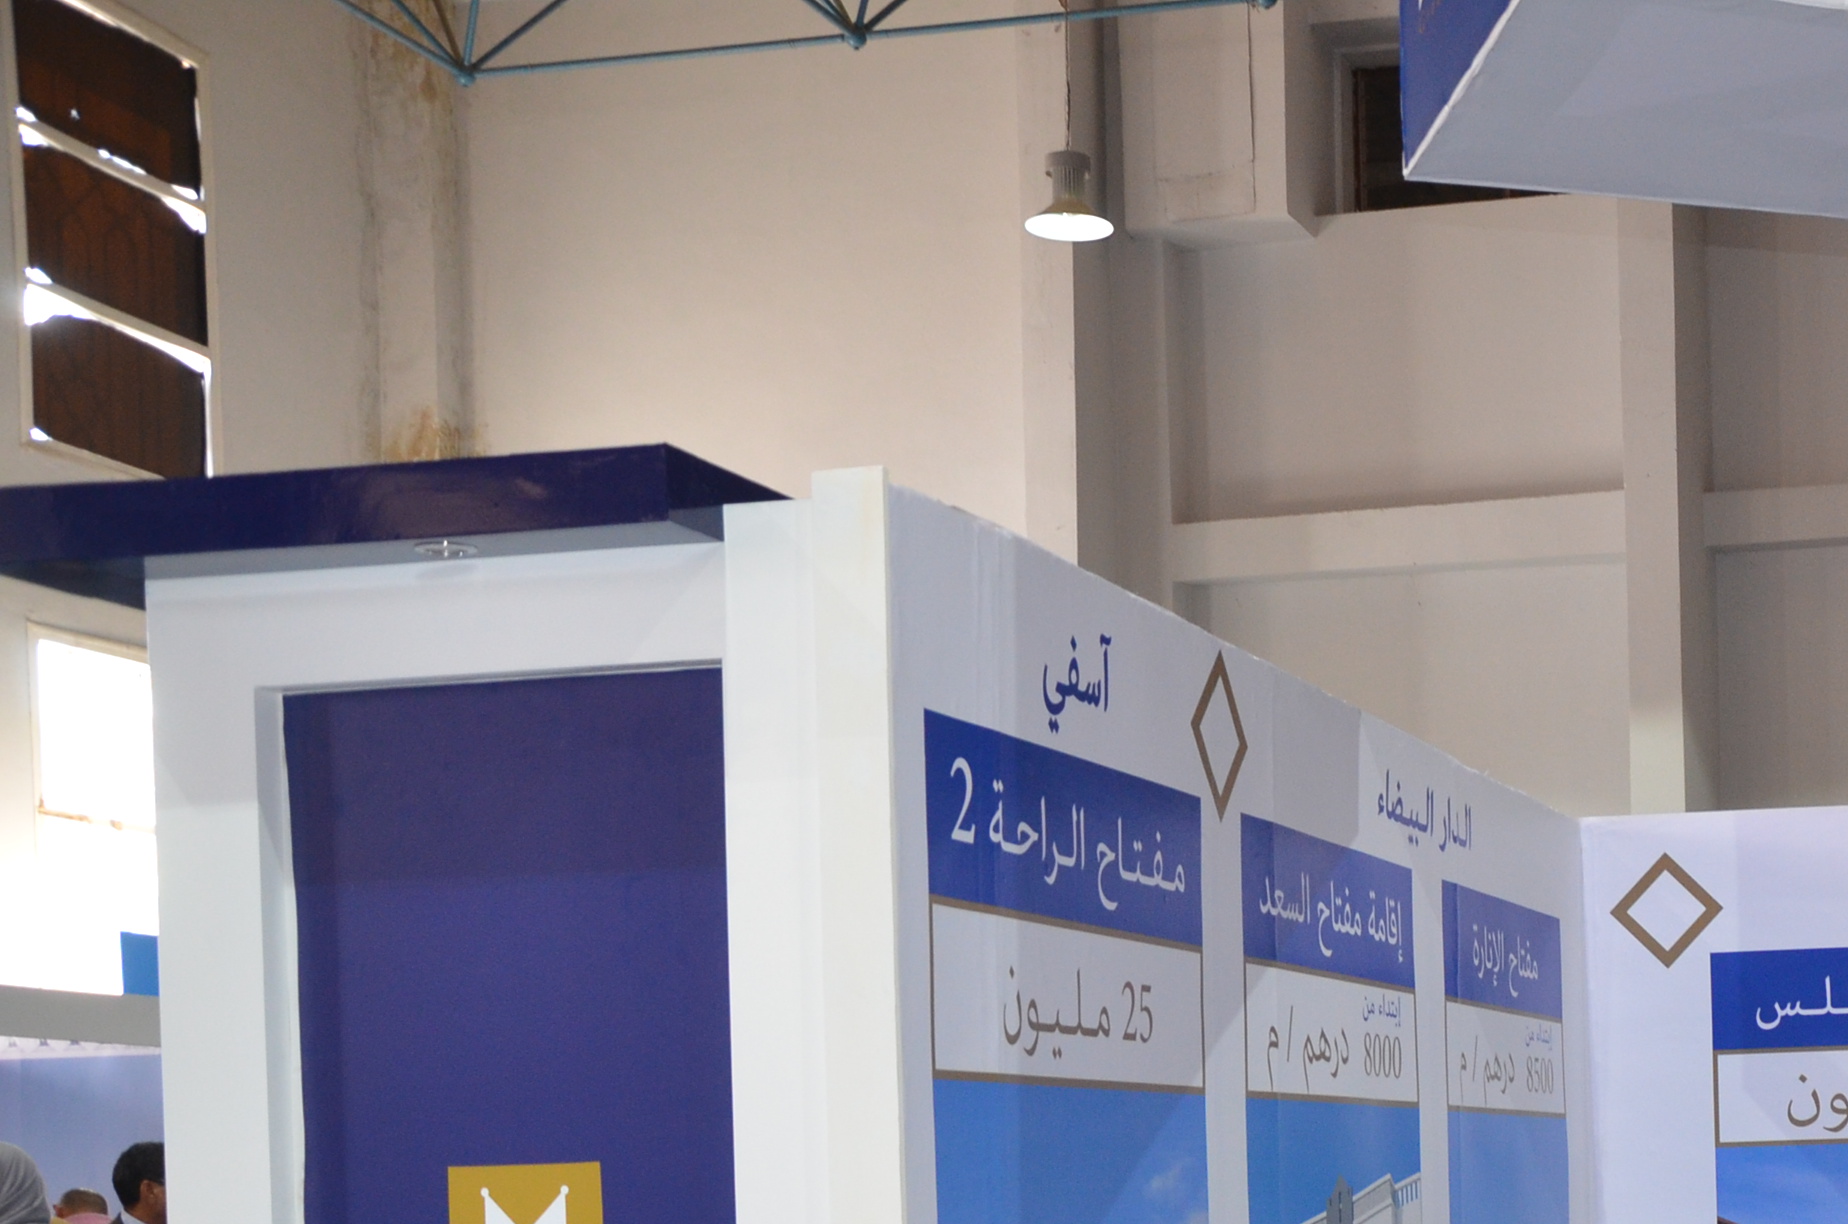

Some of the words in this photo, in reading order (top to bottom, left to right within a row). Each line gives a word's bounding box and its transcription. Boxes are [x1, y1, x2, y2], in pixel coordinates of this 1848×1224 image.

[1043, 634, 1112, 734] آسفي
[949, 756, 976, 846] 2
[987, 778, 1086, 886] الراحة
[1376, 769, 1434, 848] البيضاء
[1438, 796, 1472, 852] الدار
[1096, 817, 1186, 912] مفتاح
[1259, 871, 1311, 925] السعد
[1316, 878, 1362, 958] مفتاح
[1507, 935, 1540, 998] مفتاح
[1001, 965, 1112, 1060] مليون
[1121, 981, 1155, 1045] 25
[1302, 1024, 1350, 1093] درهم
[1364, 1031, 1402, 1080] 8000
[1525, 1055, 1555, 1095] 8500
